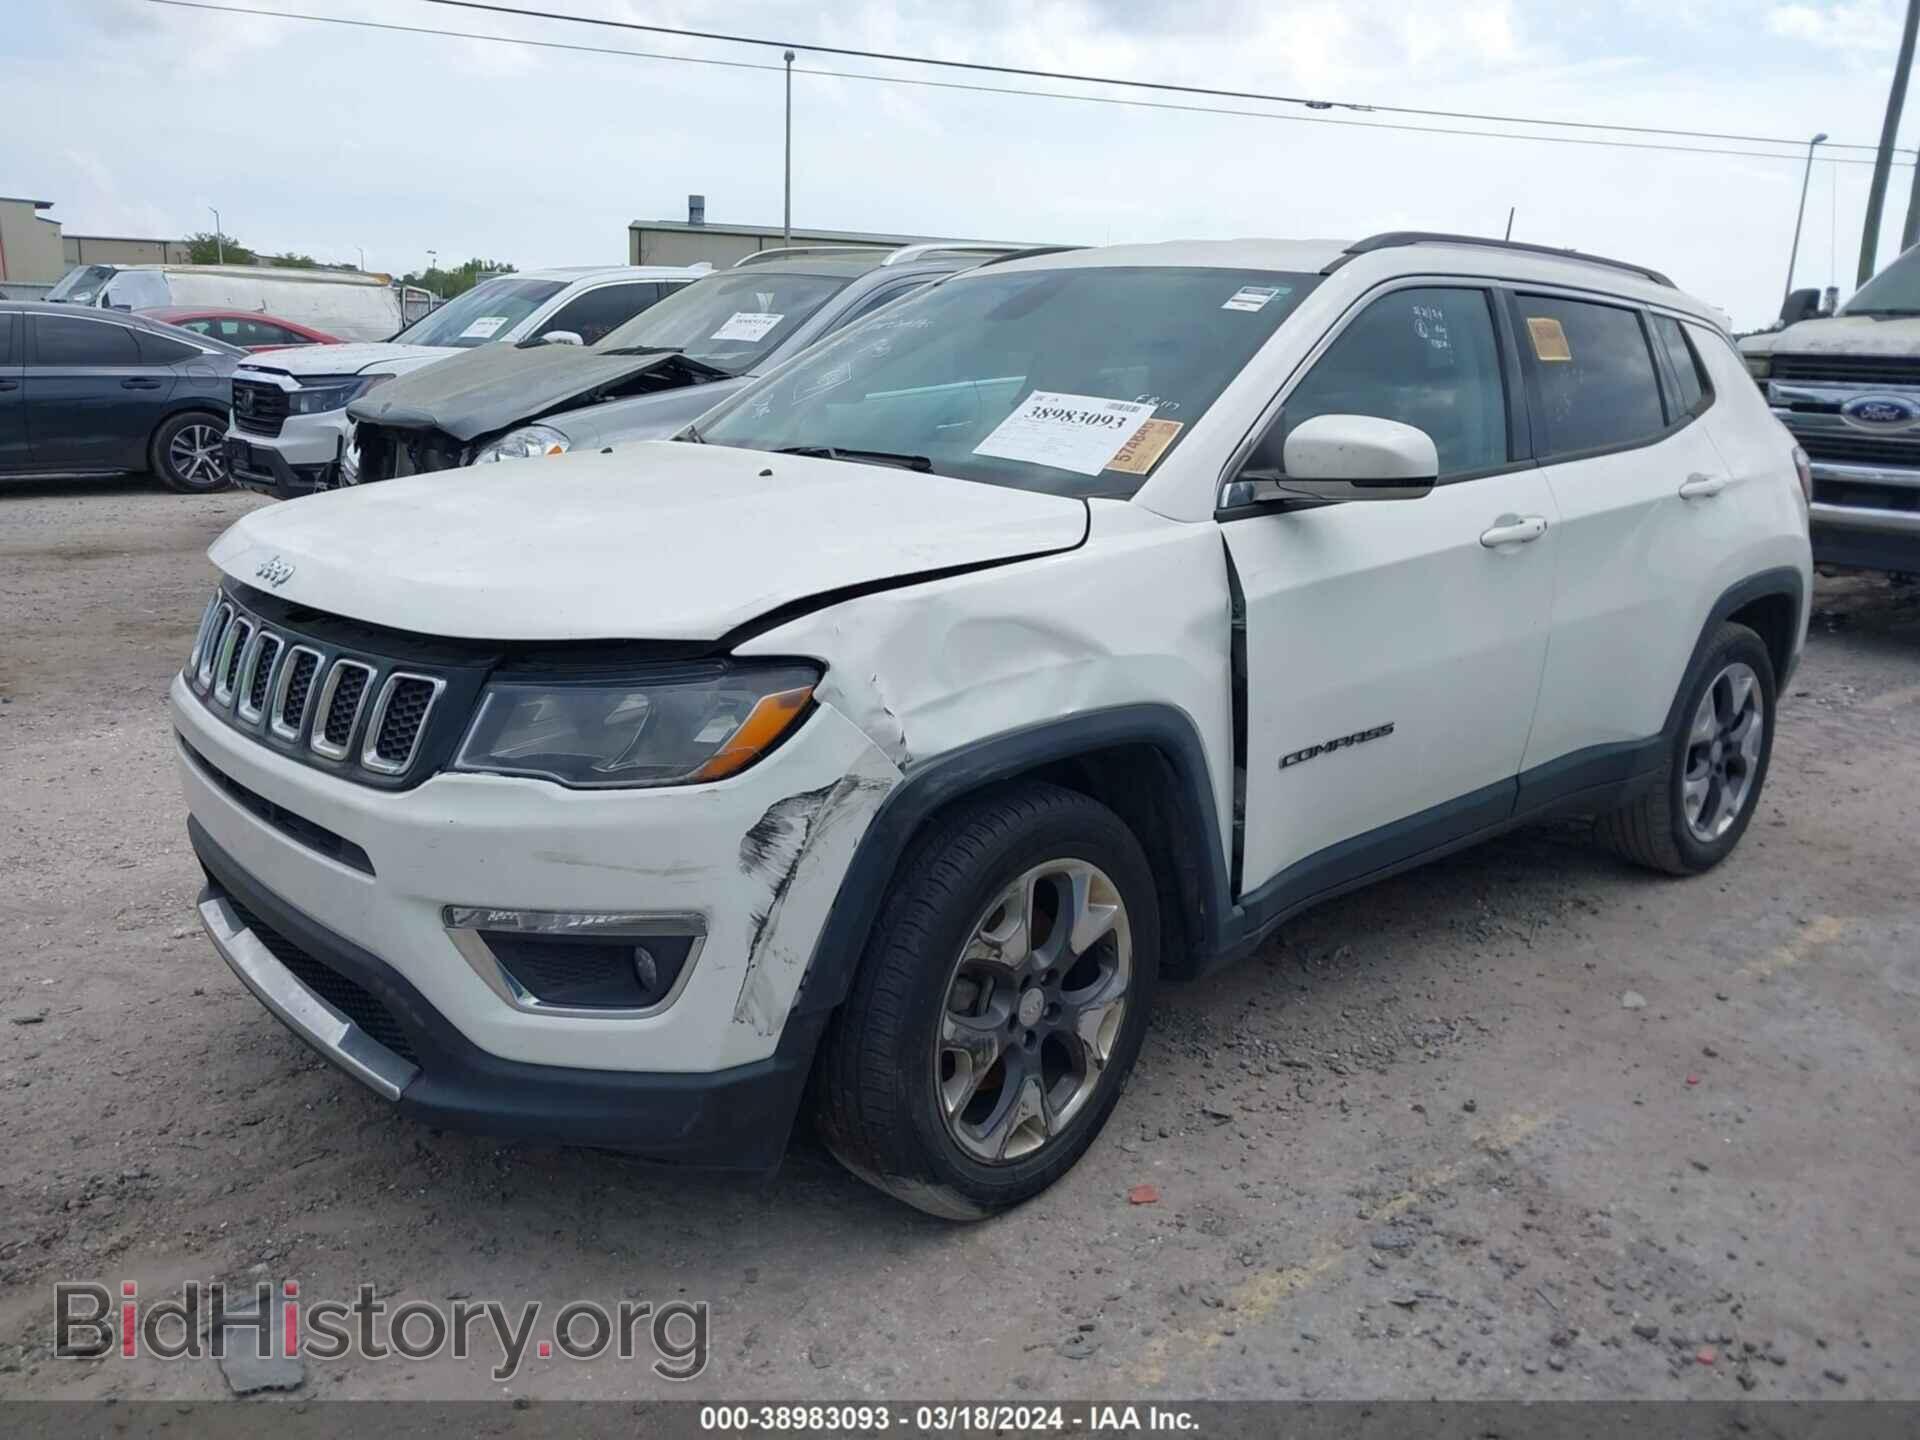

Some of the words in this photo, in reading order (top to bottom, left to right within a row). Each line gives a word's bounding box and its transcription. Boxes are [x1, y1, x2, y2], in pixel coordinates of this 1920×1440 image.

[1024, 405, 1127, 430] 38983093
[1860, 403, 1900, 420] Ford
[256, 555, 296, 588] Jeep
[1279, 722, 1394, 769] COMPASS
